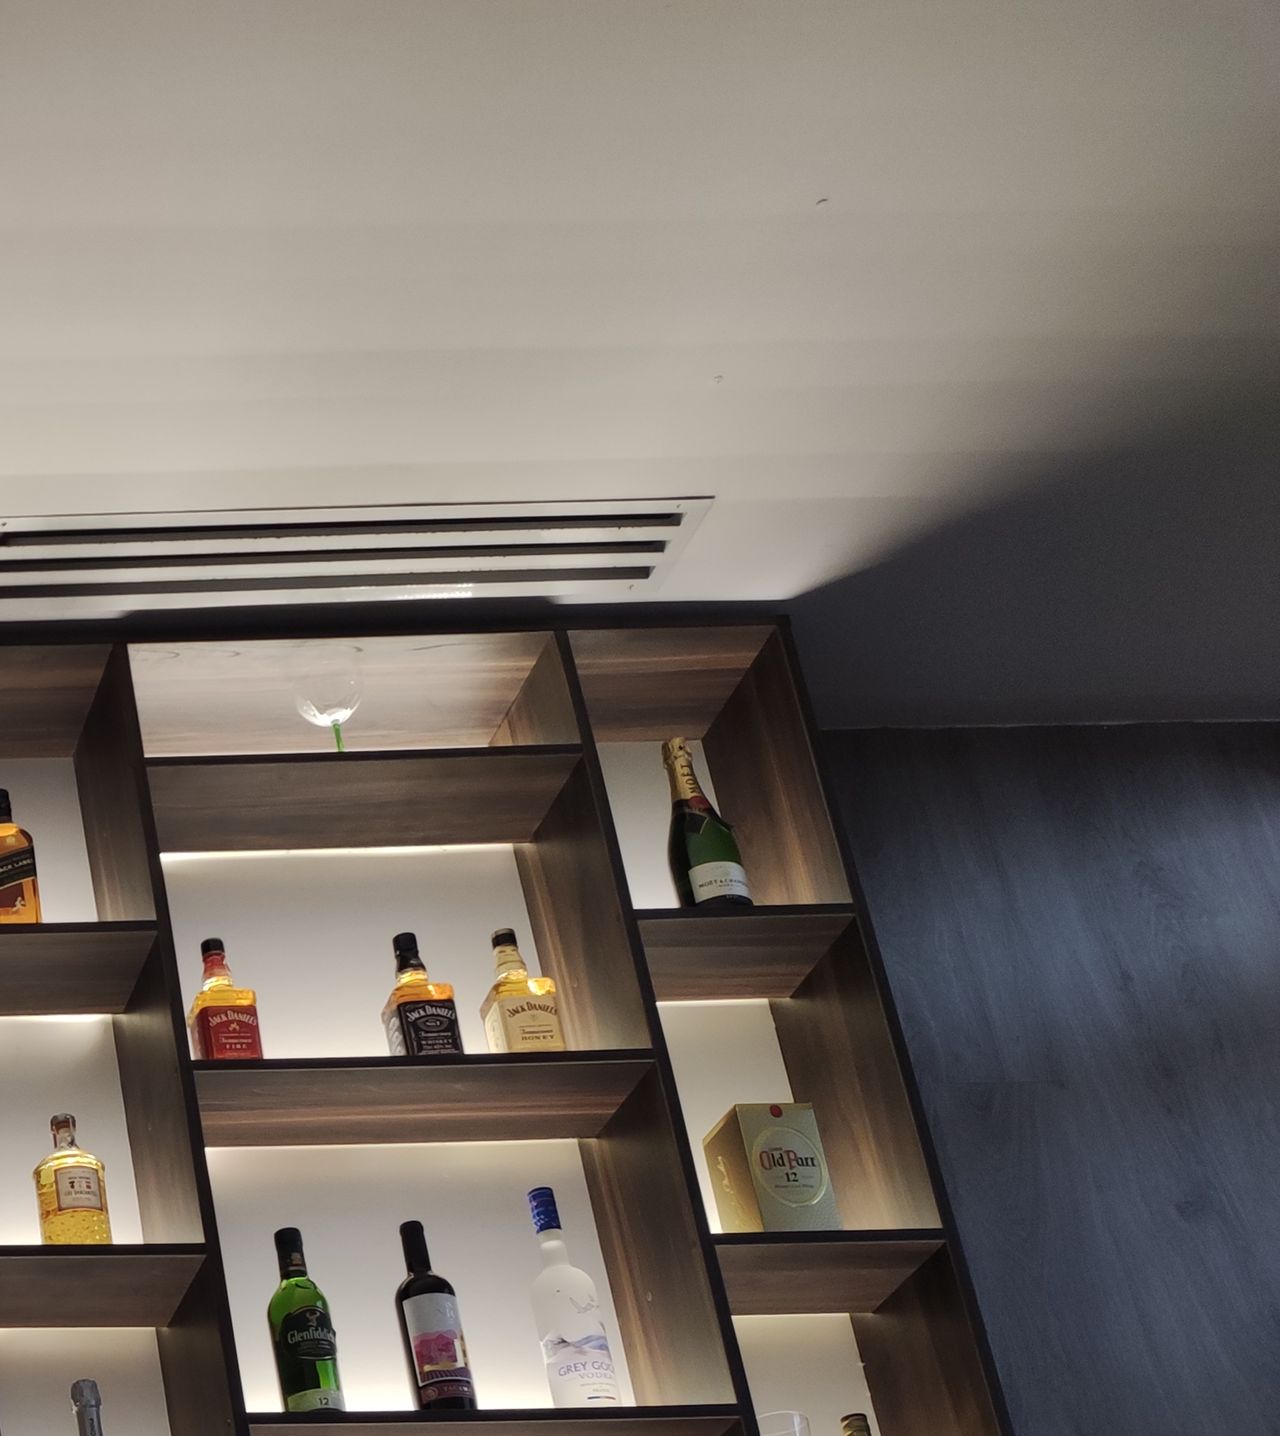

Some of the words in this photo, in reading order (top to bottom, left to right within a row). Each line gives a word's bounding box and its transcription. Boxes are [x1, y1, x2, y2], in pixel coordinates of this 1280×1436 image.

[407, 1007, 427, 1022] JACK
[506, 1005, 525, 1018] JACK
[759, 1151, 786, 1170] Old
[787, 1149, 816, 1170] Parr
[785, 1172, 799, 1183] 12
[558, 1361, 588, 1377] GREY
[318, 1397, 329, 1406] 12
